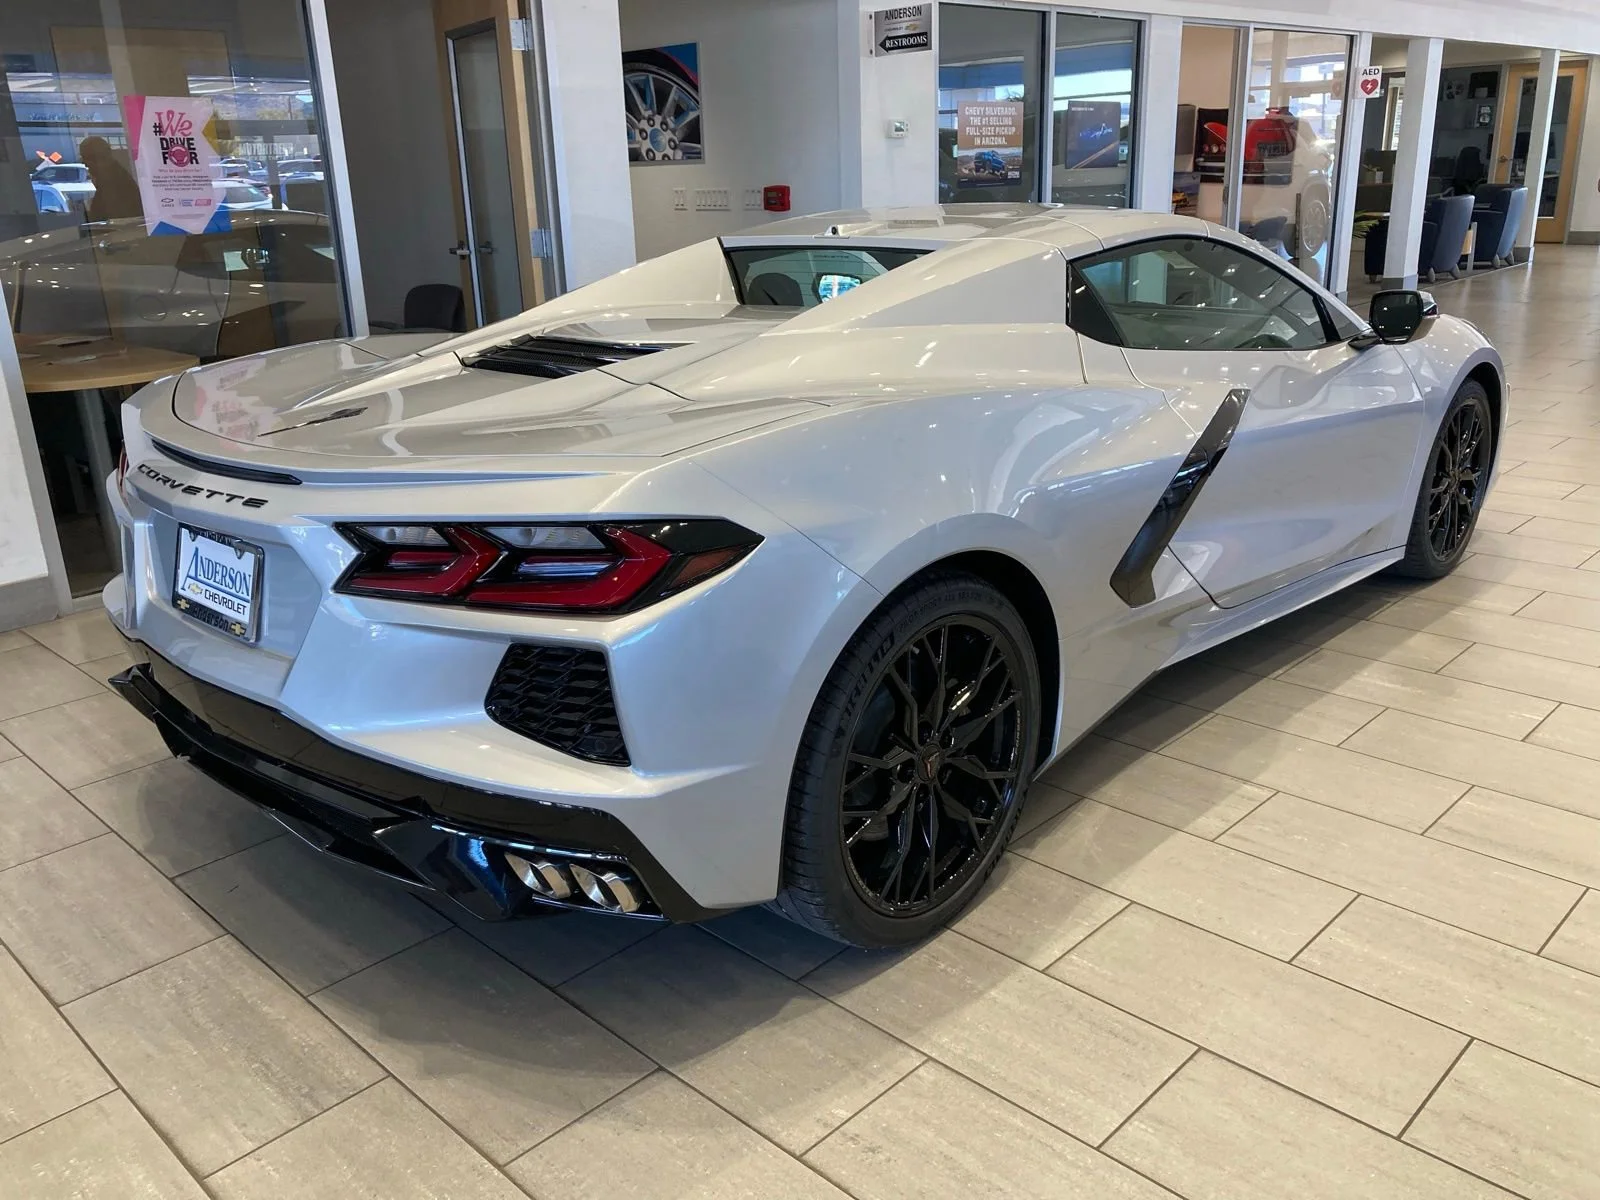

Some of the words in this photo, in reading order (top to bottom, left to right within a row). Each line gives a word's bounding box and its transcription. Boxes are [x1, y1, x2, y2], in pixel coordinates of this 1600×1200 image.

[884, 5, 922, 21] ANDERSON
[885, 35, 927, 48] RESTROOMS
[1362, 68, 1380, 76] AED
[965, 106, 984, 116] CHEVY
[970, 116, 981, 126] THE
[989, 116, 1013, 126] SELLING
[966, 126, 995, 136] FULL-SIZE
[995, 126, 1016, 136] PICKUP
[160, 138, 196, 151] DRIVE
[974, 136, 981, 146] IN
[138, 464, 269, 509] CORVETTE
[180, 547, 252, 597] ANDERSON
[204, 589, 247, 616] CHEVROLET
